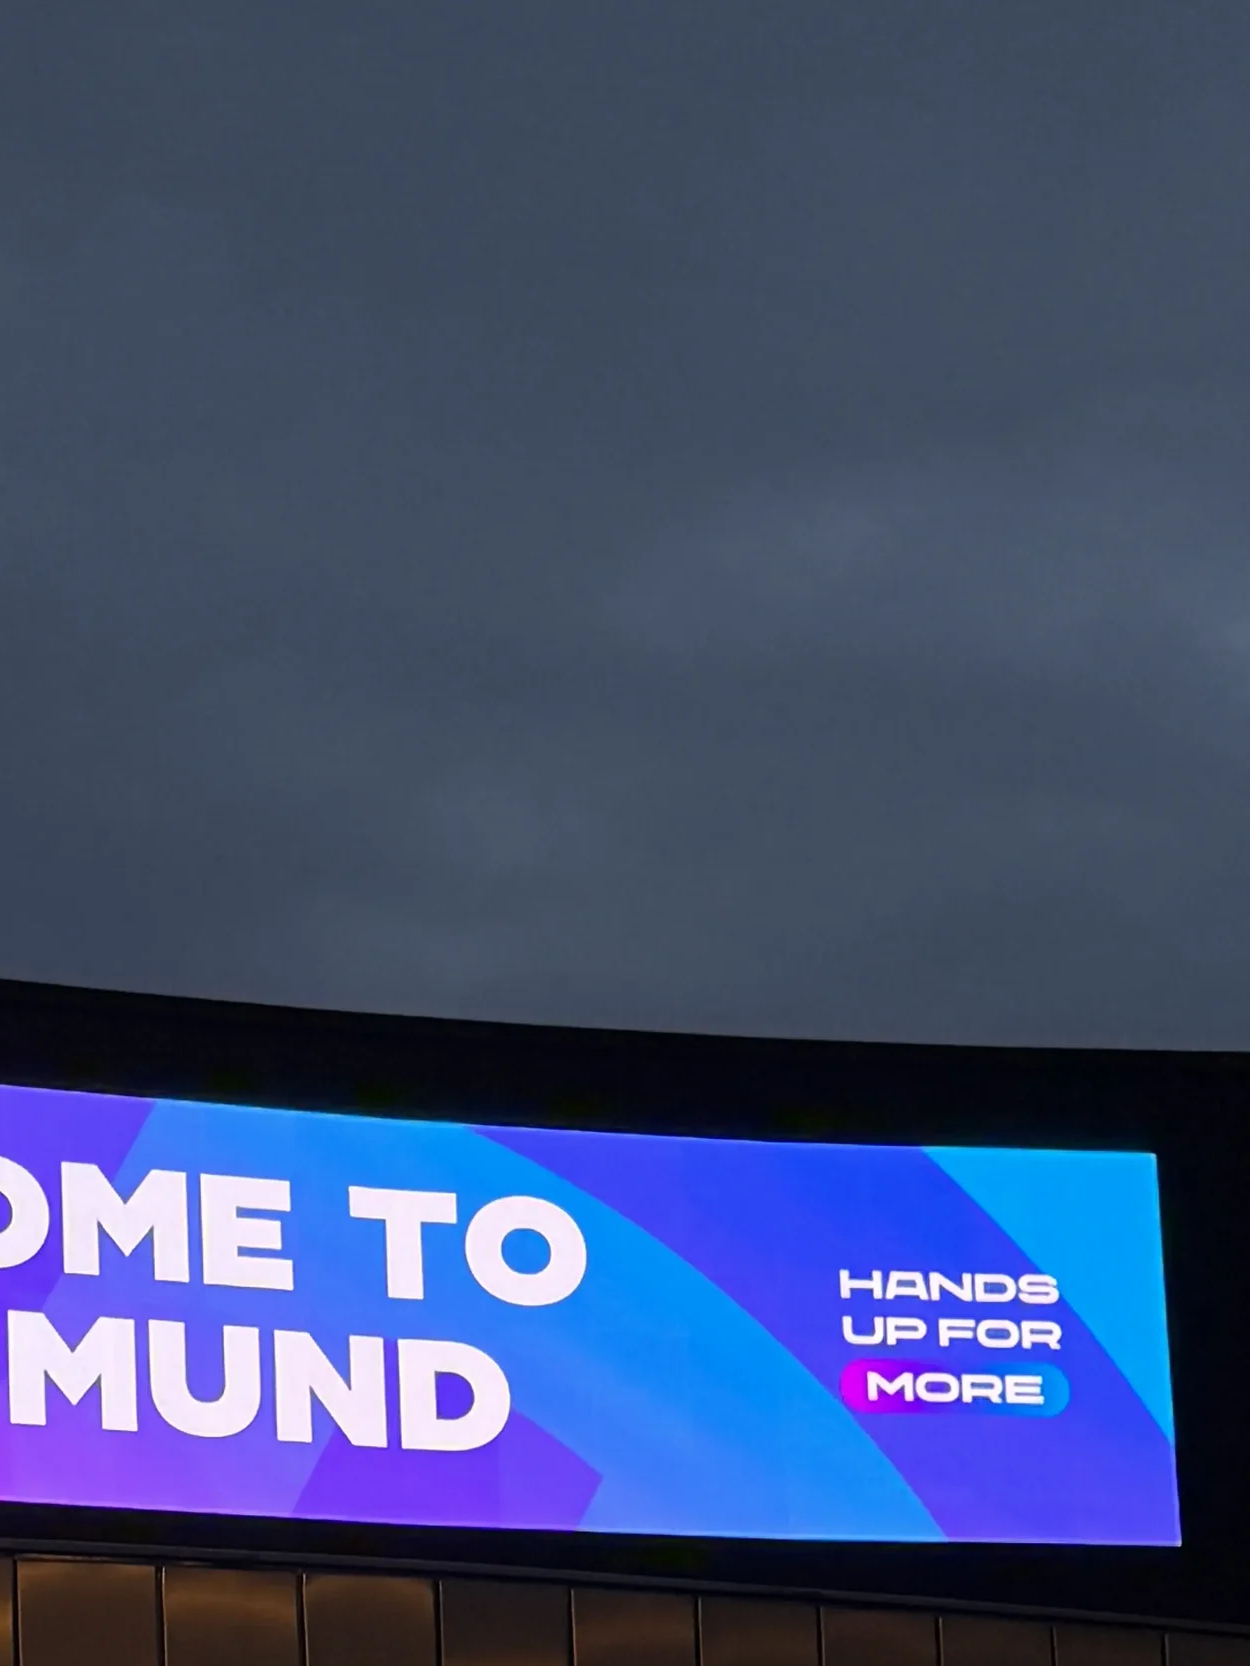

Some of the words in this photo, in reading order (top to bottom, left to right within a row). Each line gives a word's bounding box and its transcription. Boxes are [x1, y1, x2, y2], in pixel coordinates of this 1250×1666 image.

[348, 1185, 587, 1307] TO
[839, 1269, 1060, 1305] HANDS
[842, 1316, 928, 1346] UP
[938, 1318, 1063, 1350] FOR
[867, 1371, 1046, 1405] MORE
